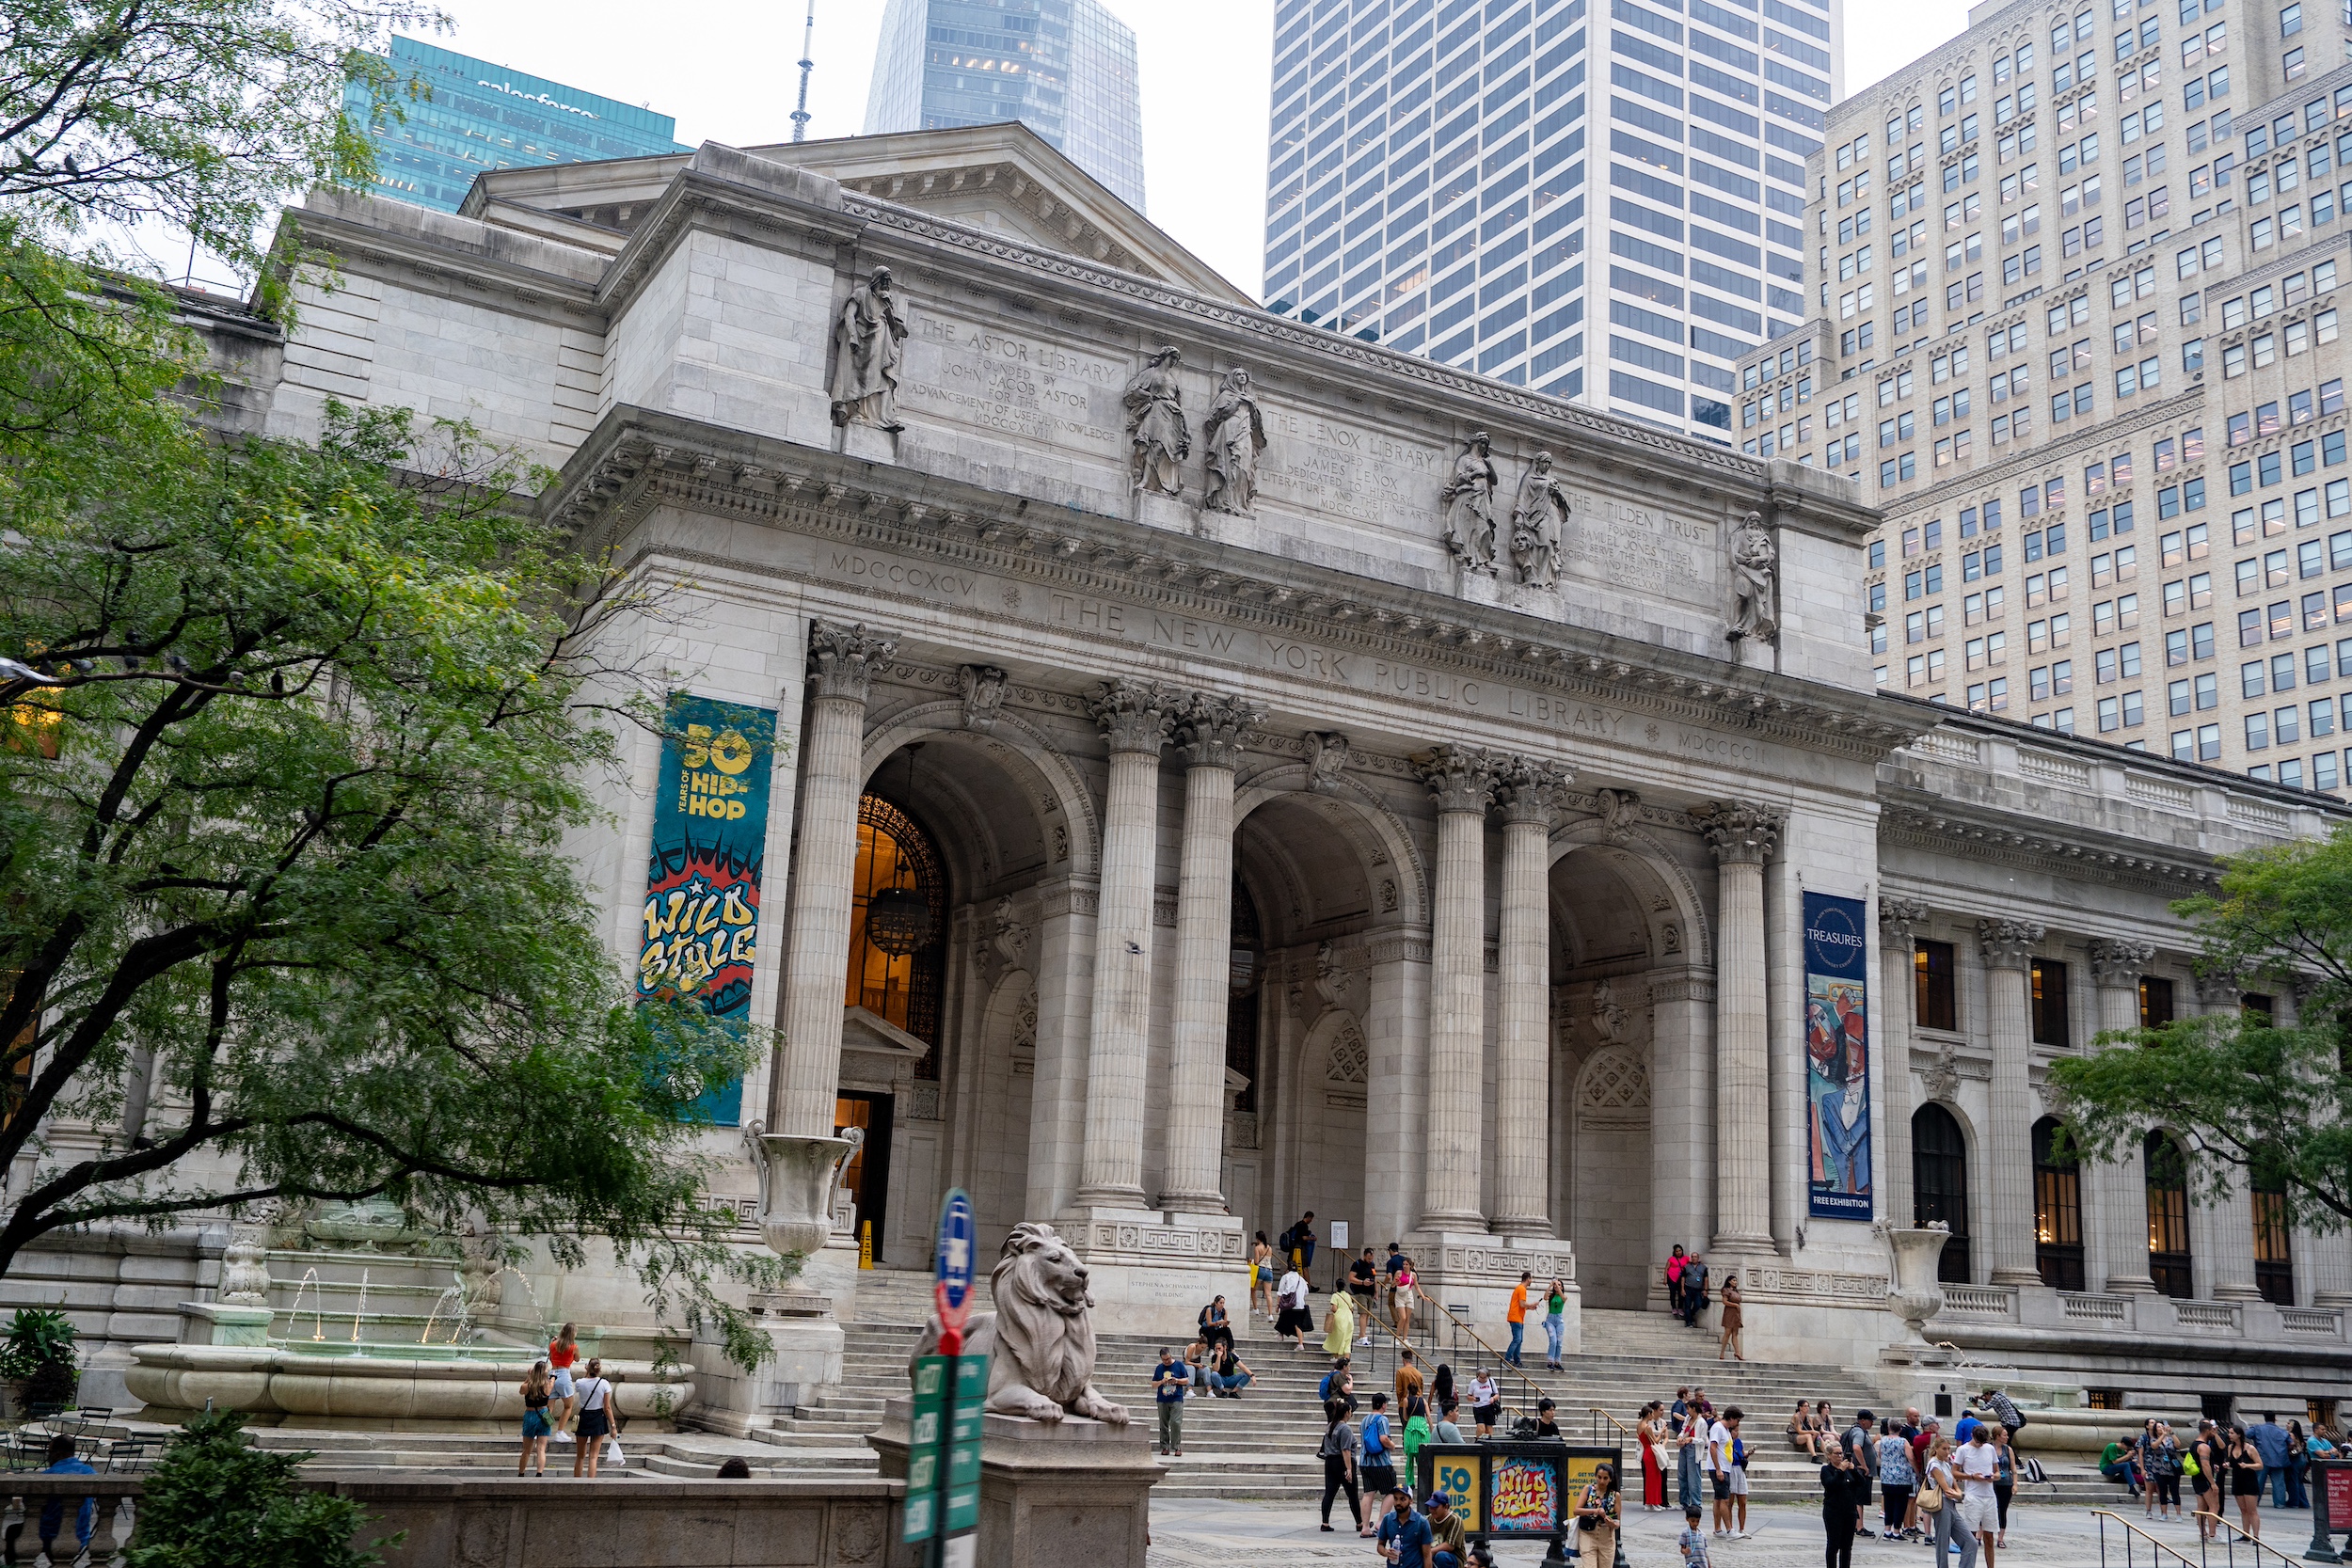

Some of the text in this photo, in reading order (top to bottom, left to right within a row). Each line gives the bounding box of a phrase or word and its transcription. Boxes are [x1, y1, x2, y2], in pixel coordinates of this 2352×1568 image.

[920, 317, 1115, 384] THE ASTOR LIBRARY
[943, 363, 1088, 409] JOHN JACOB ASTOR
[977, 357, 1057, 387] FOUNDED BY
[910, 384, 1116, 443] ADVANCEMENT OF USEFUL KNOWLEDGE
[988, 388, 1040, 410] FOR THE
[1267, 411, 1435, 469] THE LENOX LIBRARY
[1303, 456, 1398, 490] JAMES LENOX
[1317, 447, 1386, 472] FOUNDED BY
[1287, 465, 1343, 487] DEDICATED
[1349, 481, 1362, 492] TO
[1262, 471, 1434, 523] LITERATURE AND THE FINE ARTS
[1320, 499, 1379, 521] MDCCCLXX
[1565, 491, 1708, 543] THE TILDEN TRUST
[1608, 524, 1666, 546] FOUNDED BY
[1573, 538, 1699, 578] TO SERVE THE INTERESTS OF
[1580, 528, 1694, 566] SAMUEL JONES TILDEN
[1562, 548, 1709, 593] SCIENCE AND POPULAR EDUCATION
[831, 551, 1766, 765] MDCCCXCV THE NEW YORK PUBLIC LIBRARY MDCCCCII
[683, 723, 753, 775] 50
[678, 769, 690, 813] YEARS OF
[691, 771, 748, 797] HIP-
[689, 794, 746, 820] HOP
[1807, 928, 1862, 947] TREASURES
[1813, 1196, 1868, 1208] FREE EXHIBITION
[1440, 1466, 1471, 1493] 50
